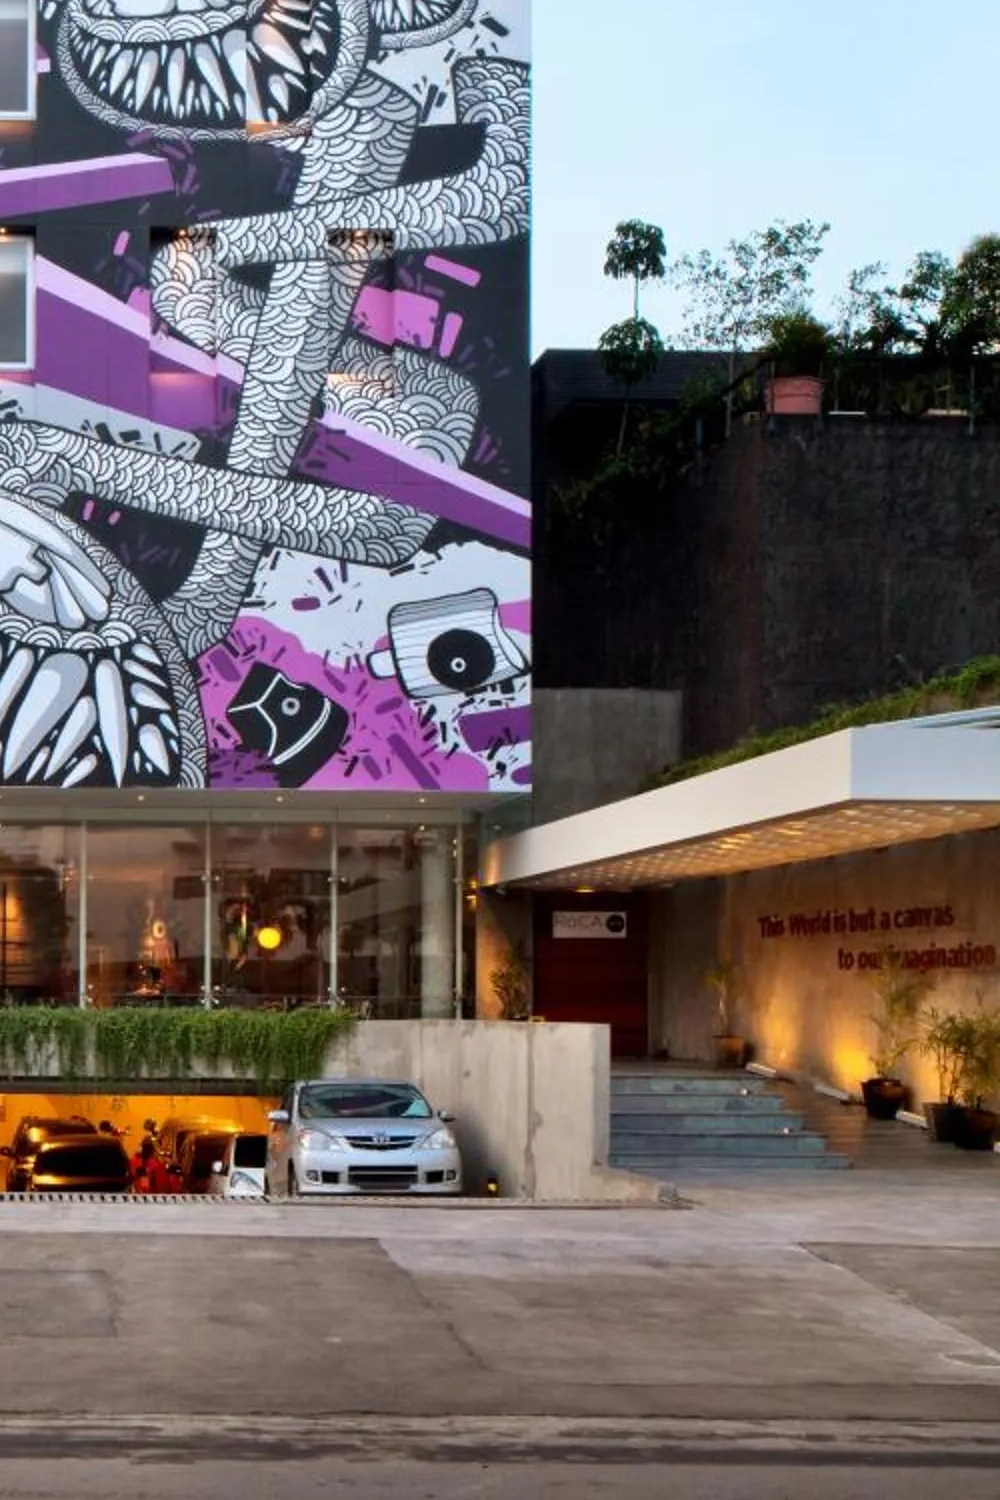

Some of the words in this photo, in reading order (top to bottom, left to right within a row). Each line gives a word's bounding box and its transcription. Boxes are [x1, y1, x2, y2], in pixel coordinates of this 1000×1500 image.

[758, 915, 785, 938] This
[788, 910, 831, 936] World
[833, 909, 847, 933] is
[849, 907, 876, 932] but
[880, 911, 891, 931] a
[893, 905, 955, 929] canvas
[837, 947, 855, 970] to
